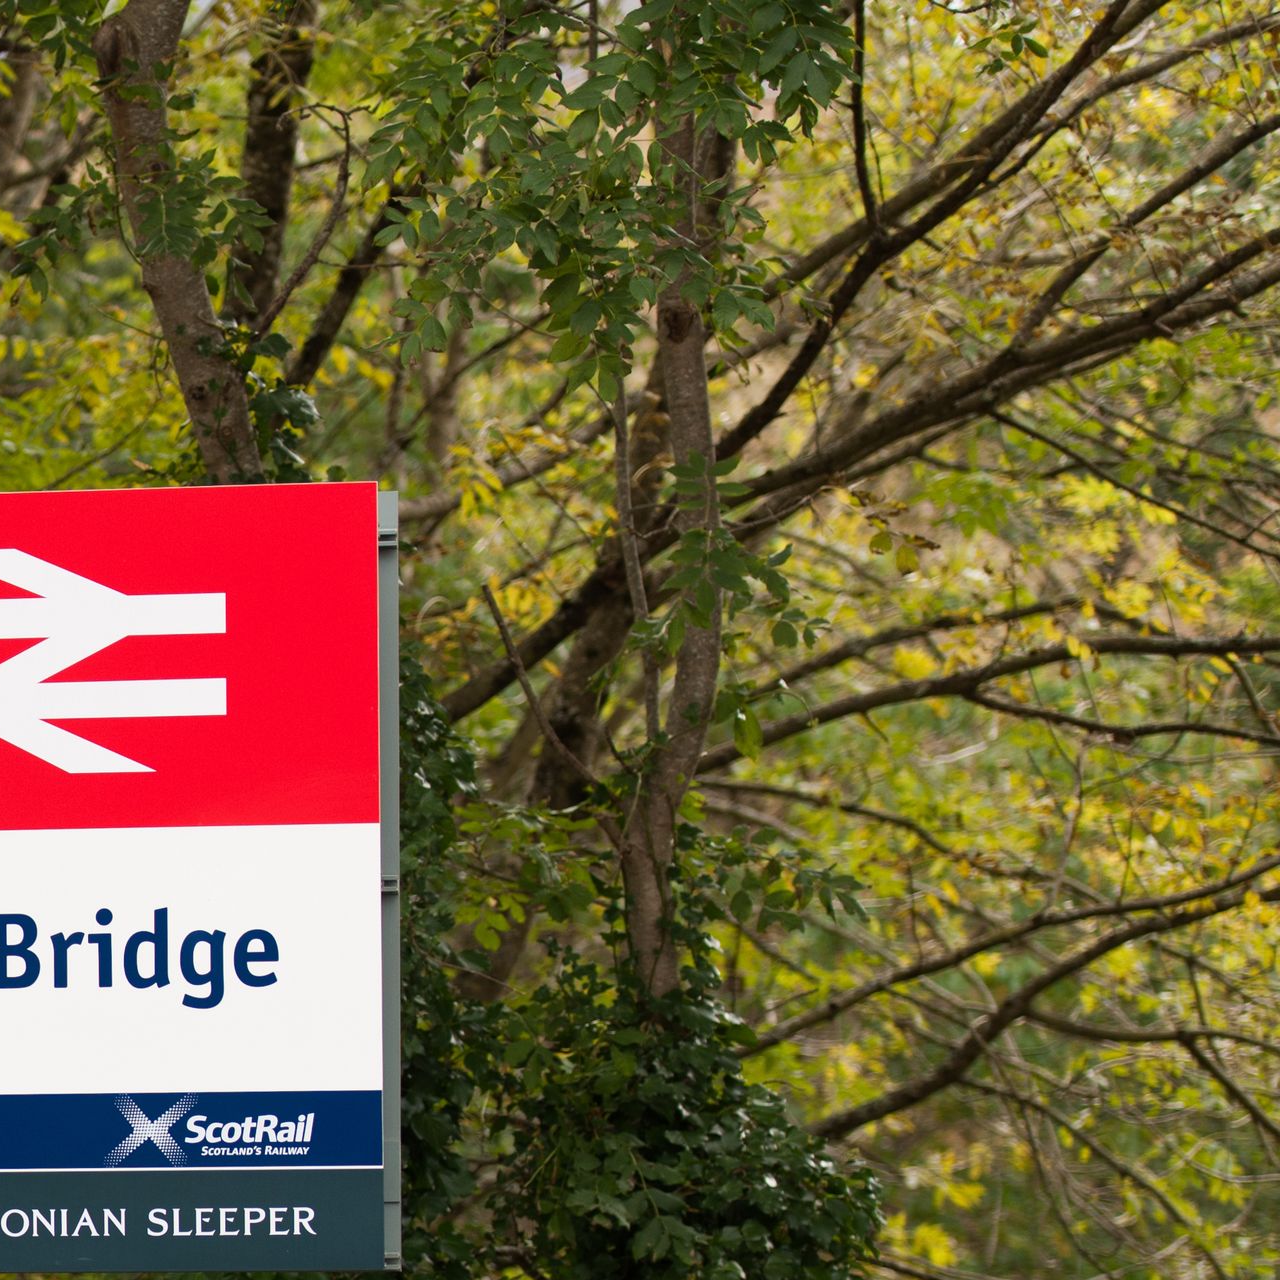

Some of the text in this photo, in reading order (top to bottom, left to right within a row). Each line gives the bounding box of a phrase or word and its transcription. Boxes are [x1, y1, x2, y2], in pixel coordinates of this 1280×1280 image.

[184, 1112, 315, 1144] ScotRail
[201, 1145, 310, 1156] SCOTLAND'S RAILWAY
[146, 1206, 317, 1237] SLEEPER
